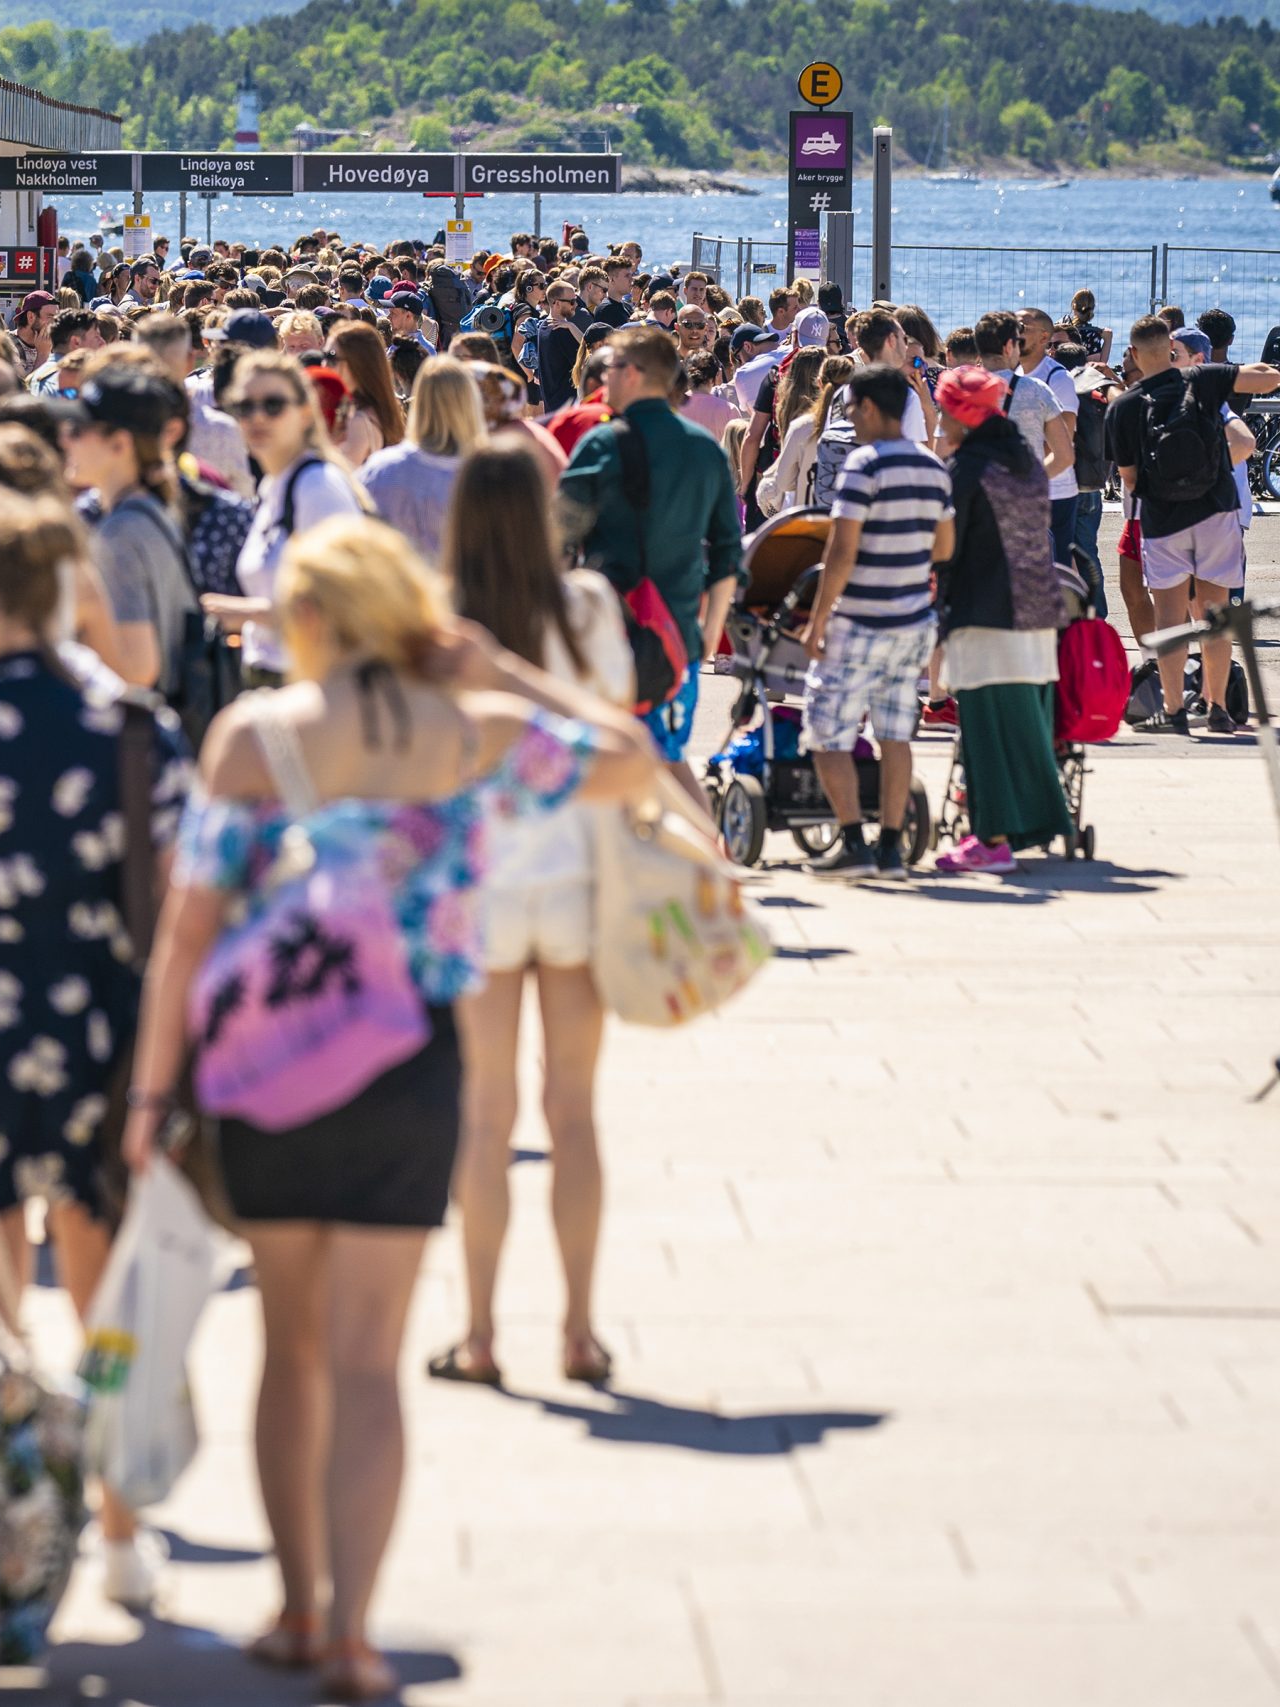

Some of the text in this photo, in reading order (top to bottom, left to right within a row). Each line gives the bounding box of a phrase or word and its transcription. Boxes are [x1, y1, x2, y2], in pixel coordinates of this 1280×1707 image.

[811, 70, 830, 97] E
[16, 157, 97, 172] Lindøya vest
[180, 158, 255, 173] Lindøya øst
[16, 173, 97, 186] Nakkholmen
[190, 174, 245, 189] Bleikøya
[329, 164, 429, 188] Hovedøya
[472, 164, 609, 184] Gressholmen
[817, 174, 844, 183] brygge
